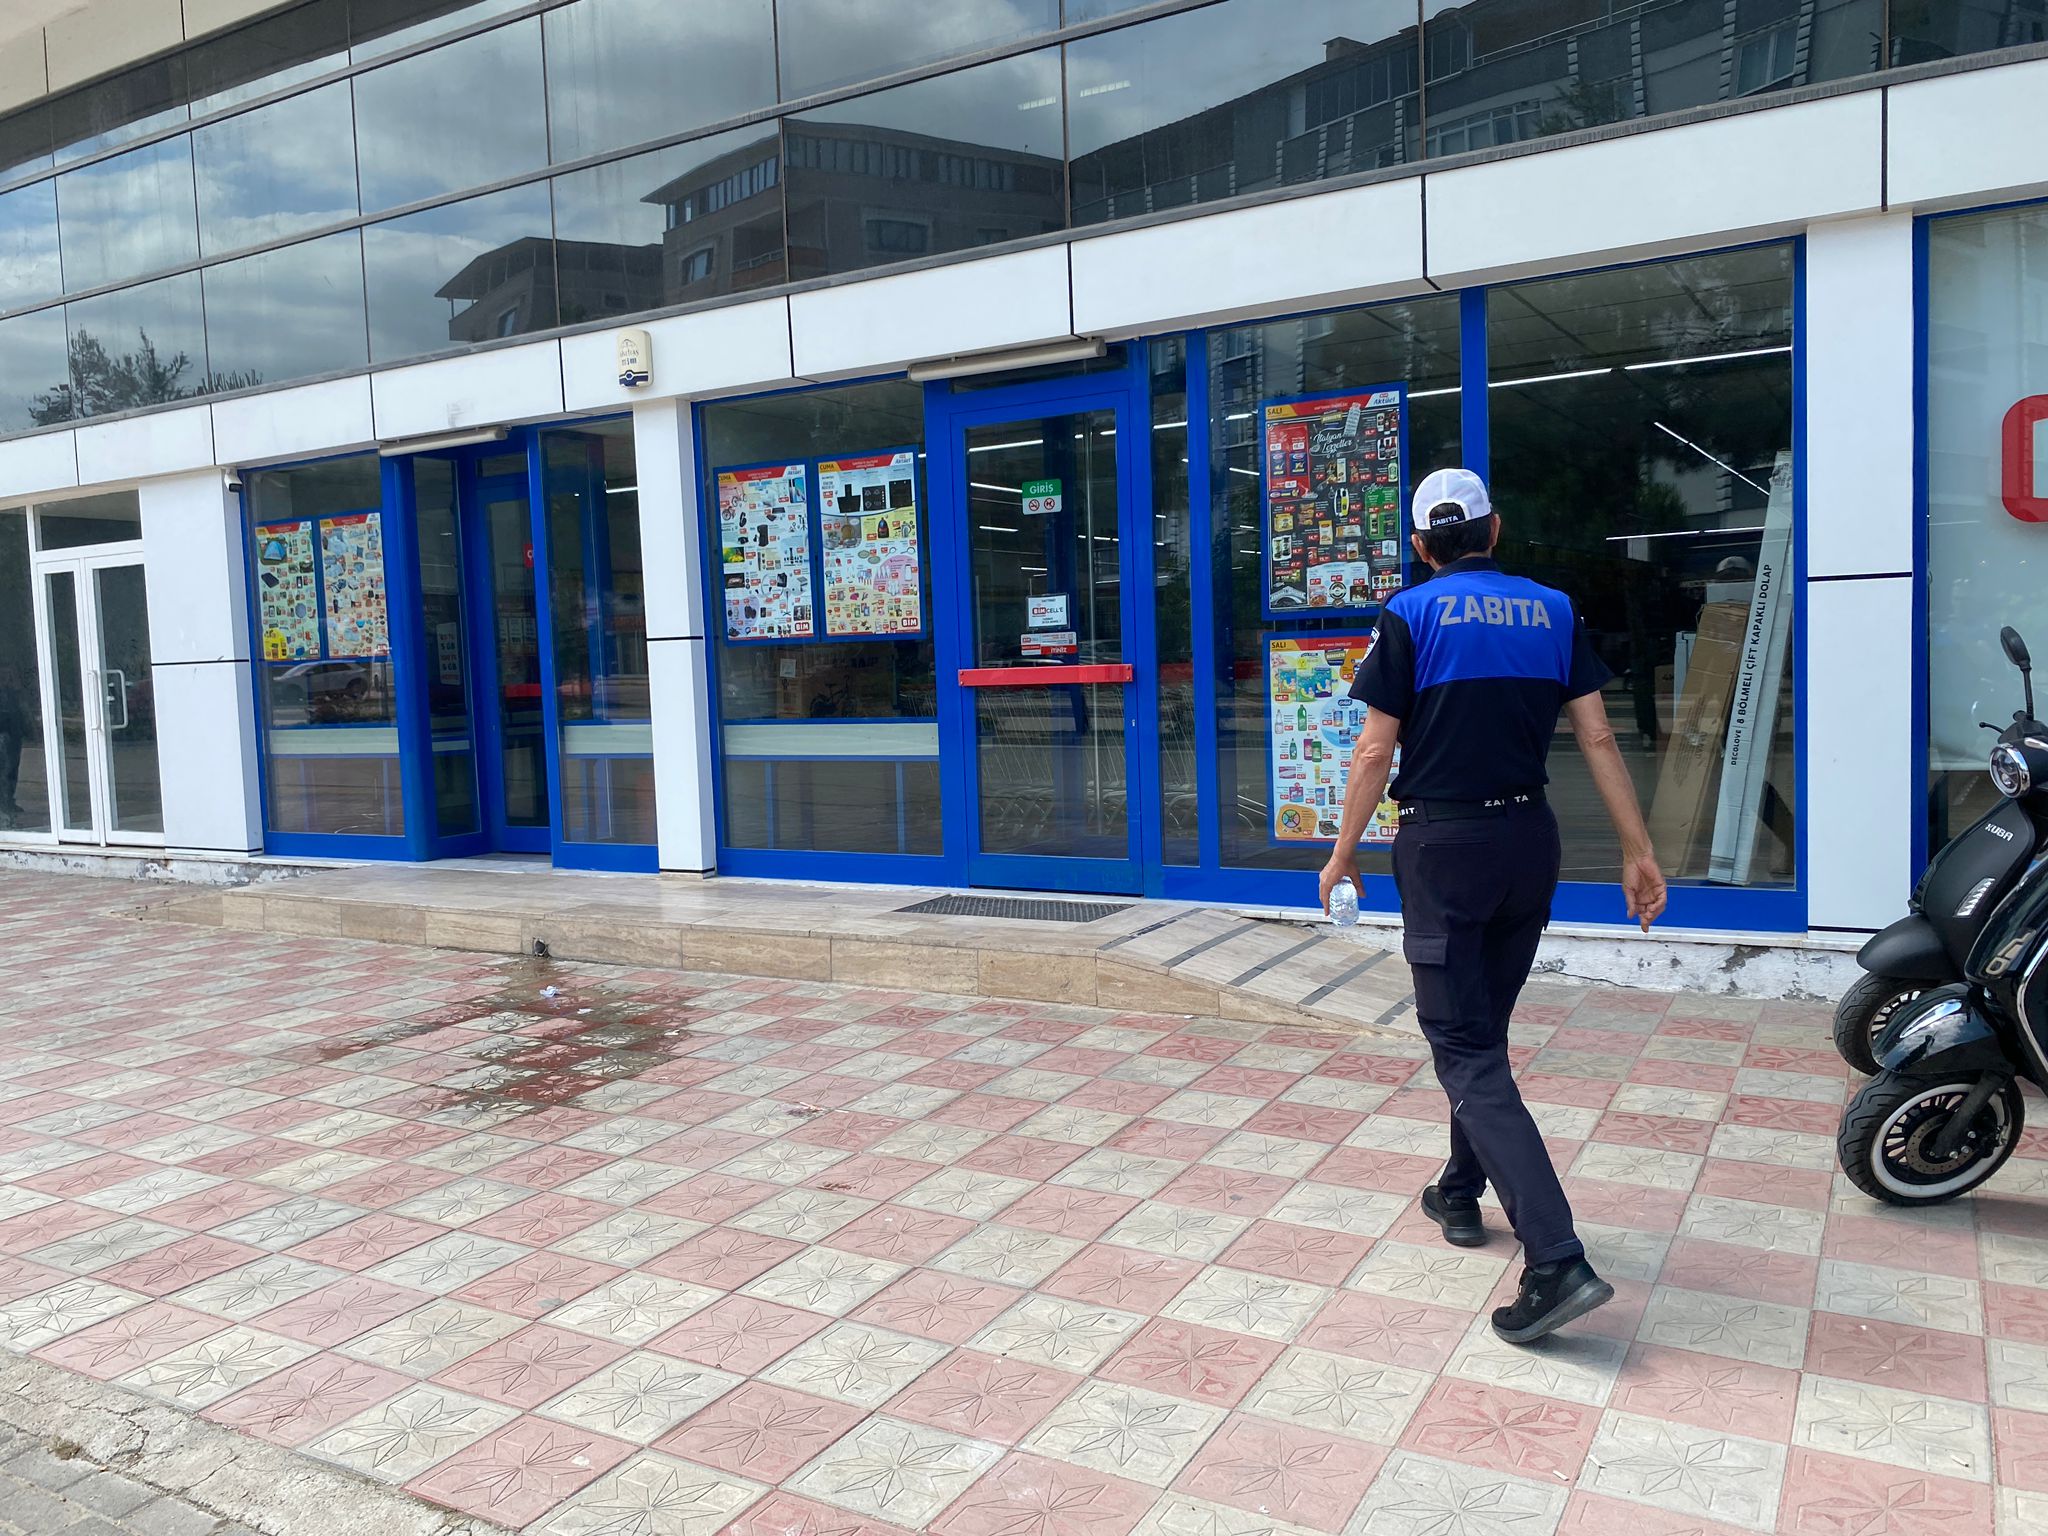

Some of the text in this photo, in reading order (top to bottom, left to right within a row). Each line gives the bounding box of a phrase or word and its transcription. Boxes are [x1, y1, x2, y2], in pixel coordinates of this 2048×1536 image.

[1267, 407, 1283, 416] SALI
[1030, 481, 1054, 495] GİRİŞ
[1431, 514, 1459, 526] ZABITA
[1437, 595, 1552, 629] ZABITA
[1731, 729, 1741, 765] DECOLOVE
[1737, 672, 1753, 715] BÖLMELİ
[1745, 648, 1757, 670] ÇİFT
[1751, 602, 1766, 645] KAPAKLI
[1759, 564, 1772, 599] DOLAP
[1484, 794, 1529, 807] ZATA
[1985, 823, 2014, 841] KUBA
